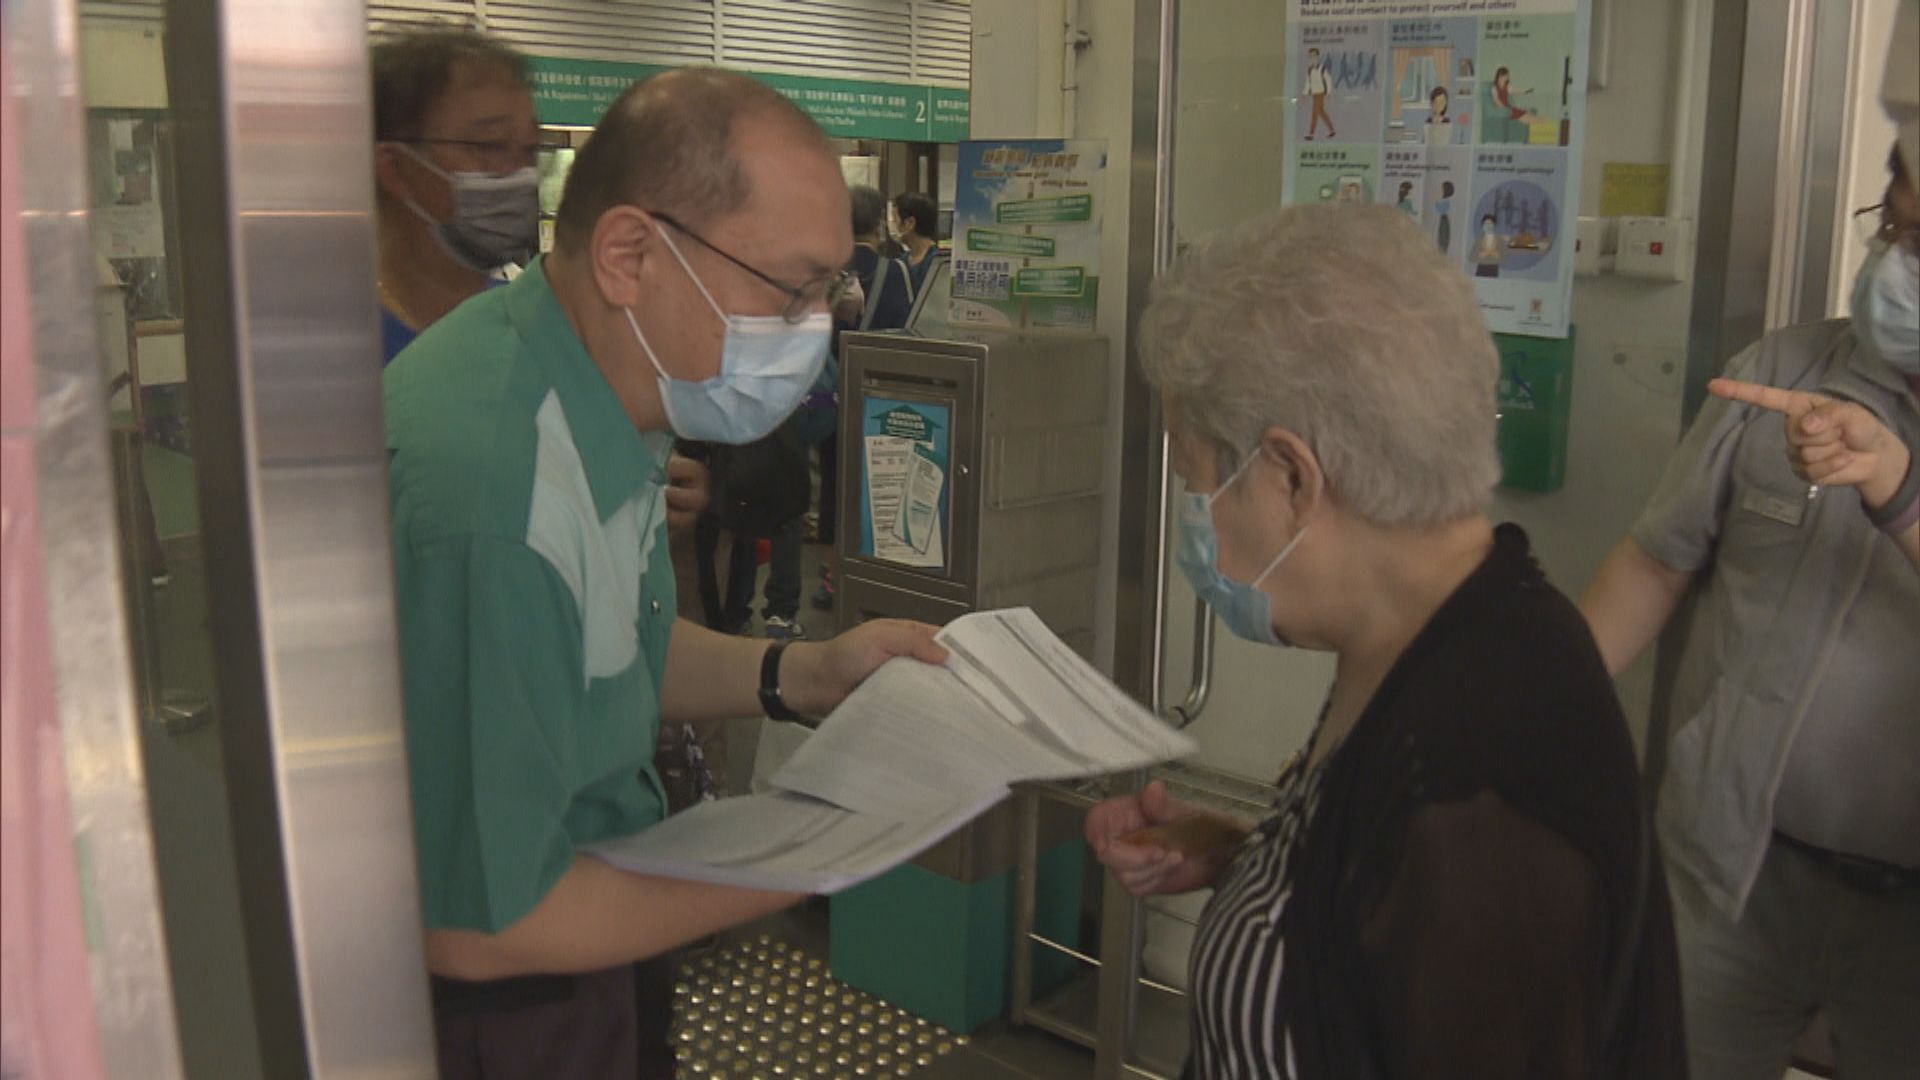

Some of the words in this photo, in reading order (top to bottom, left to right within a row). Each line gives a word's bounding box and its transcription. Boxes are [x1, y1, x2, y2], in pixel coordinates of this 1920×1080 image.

[1300, 7, 1329, 17] Reduce
[1331, 6, 1355, 15] social
[1357, 5, 1387, 14] contact
[1399, 4, 1429, 14] protect
[1432, 1, 1468, 12] yourself
[1469, 2, 1486, 10] and
[1487, 0, 1516, 9] others
[915, 100, 926, 124] 2
